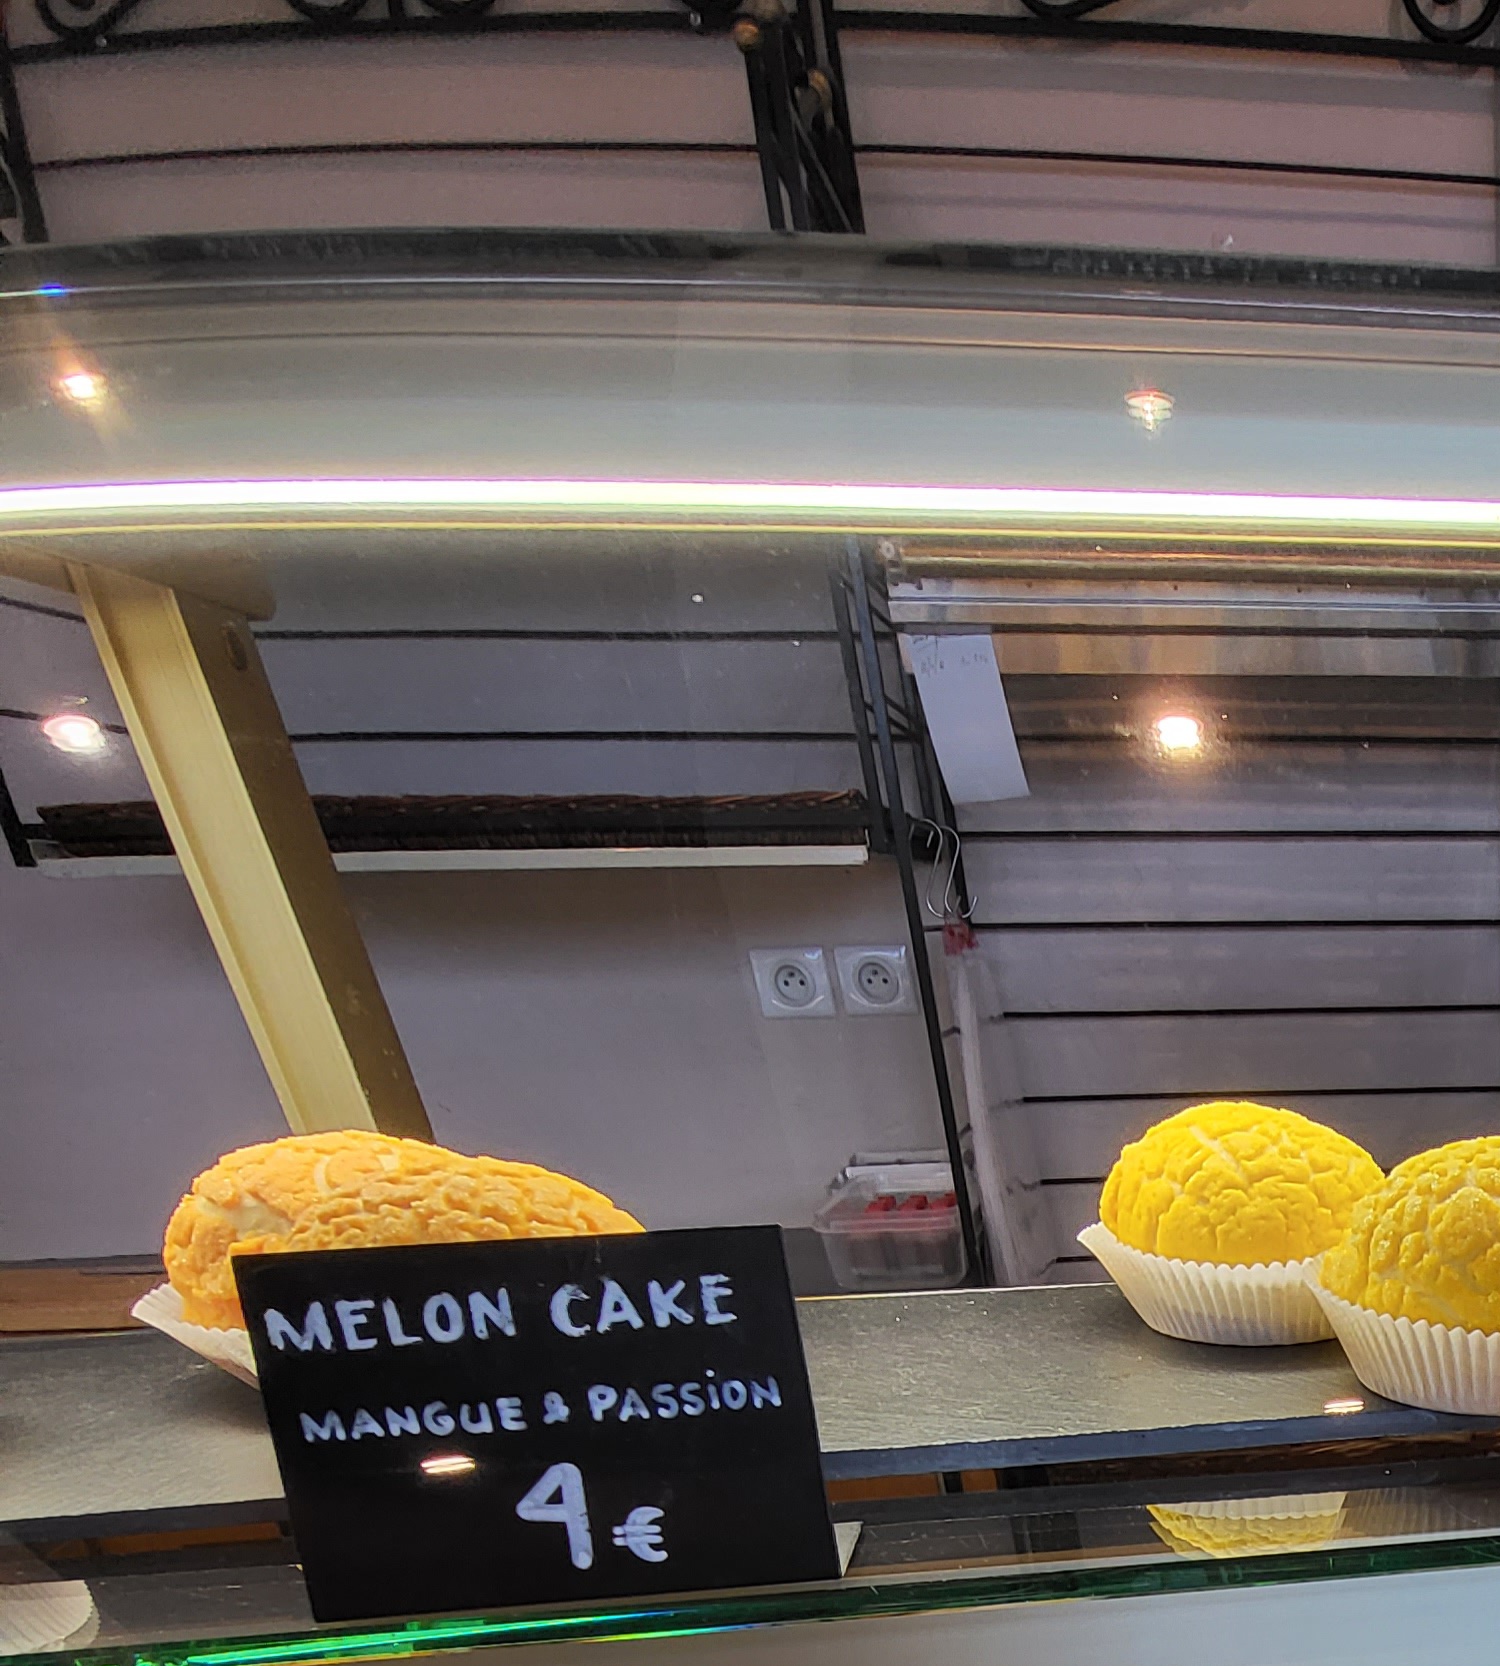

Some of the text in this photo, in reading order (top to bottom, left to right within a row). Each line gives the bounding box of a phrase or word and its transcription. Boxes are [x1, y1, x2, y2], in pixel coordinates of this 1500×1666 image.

[262, 1273, 739, 1353] MELON CAKE
[300, 1395, 527, 1444] MANGUE
[542, 1392, 570, 1424] &
